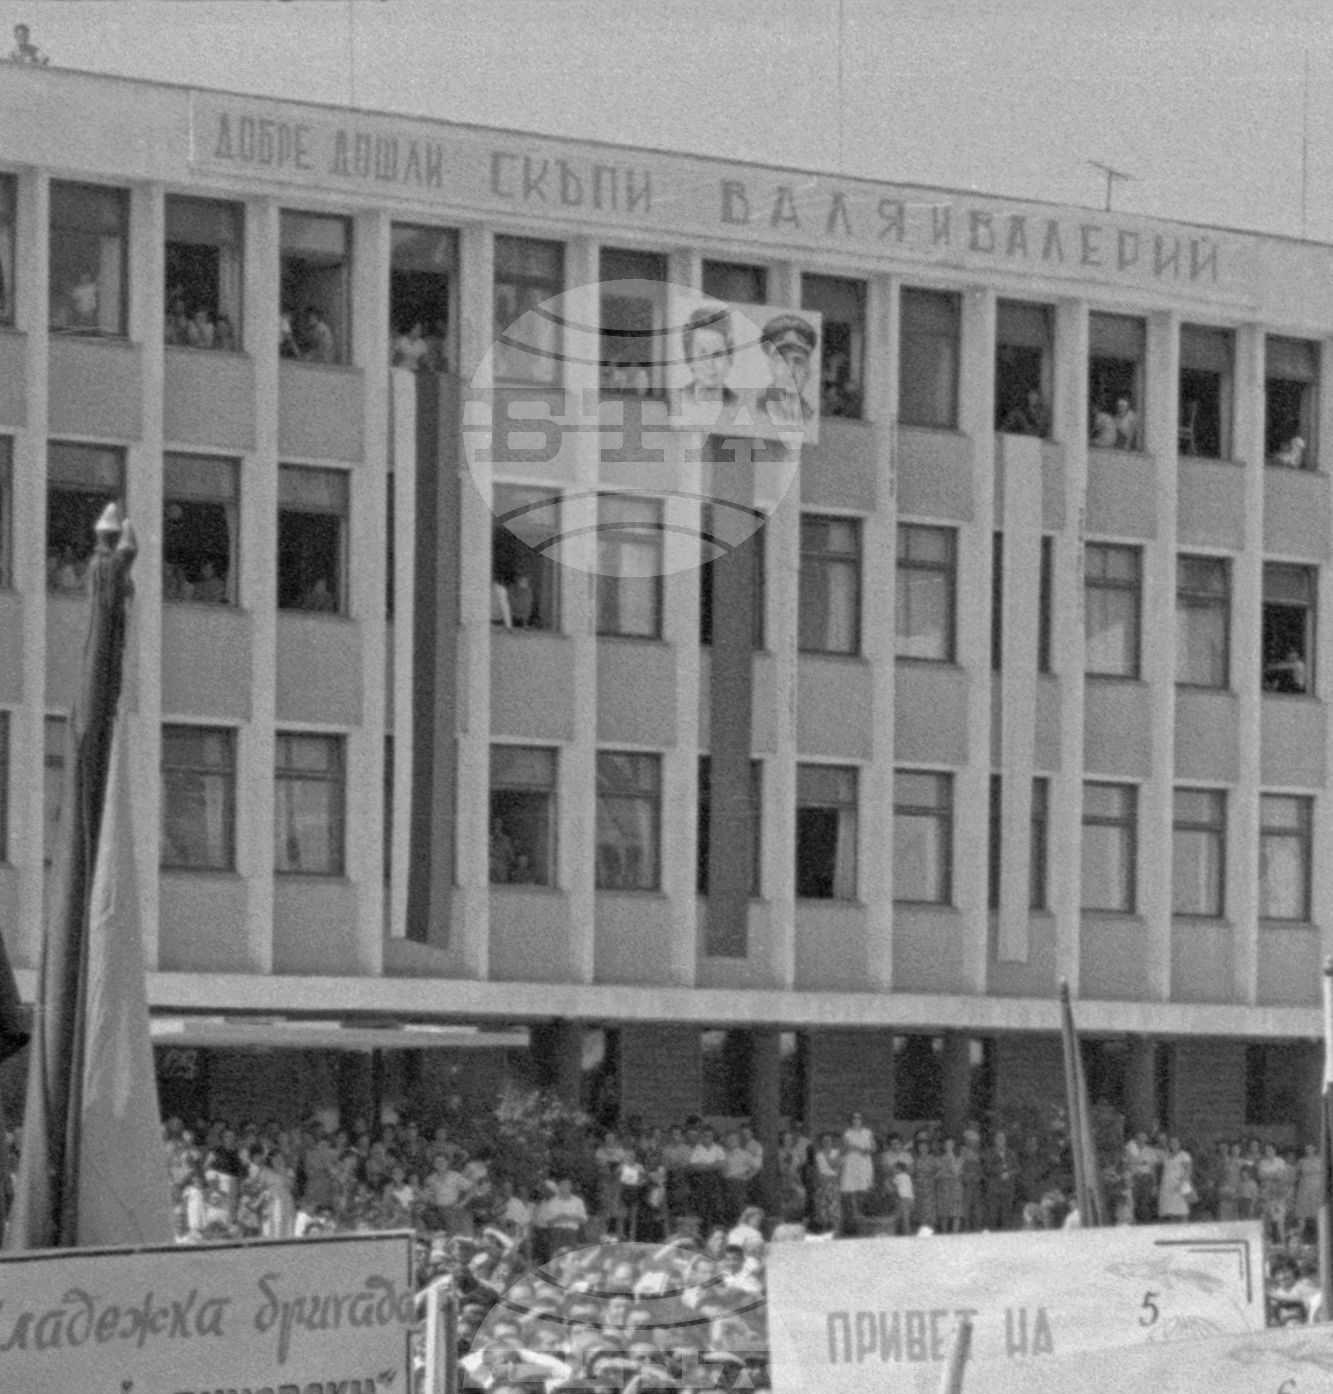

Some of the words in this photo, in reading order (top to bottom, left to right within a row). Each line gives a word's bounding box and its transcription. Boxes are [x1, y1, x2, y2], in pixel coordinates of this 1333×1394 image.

[213, 112, 312, 170] ДОБРЕ
[329, 127, 443, 188] ДОШЛИ
[488, 150, 652, 213] СКЪПИ
[720, 179, 905, 243] ВАЛЯ
[0, 1287, 230, 1351] ладежка
[254, 1271, 419, 1365] бригада
[1006, 1306, 1054, 1358] НА
[1138, 1291, 1160, 1327] 5
